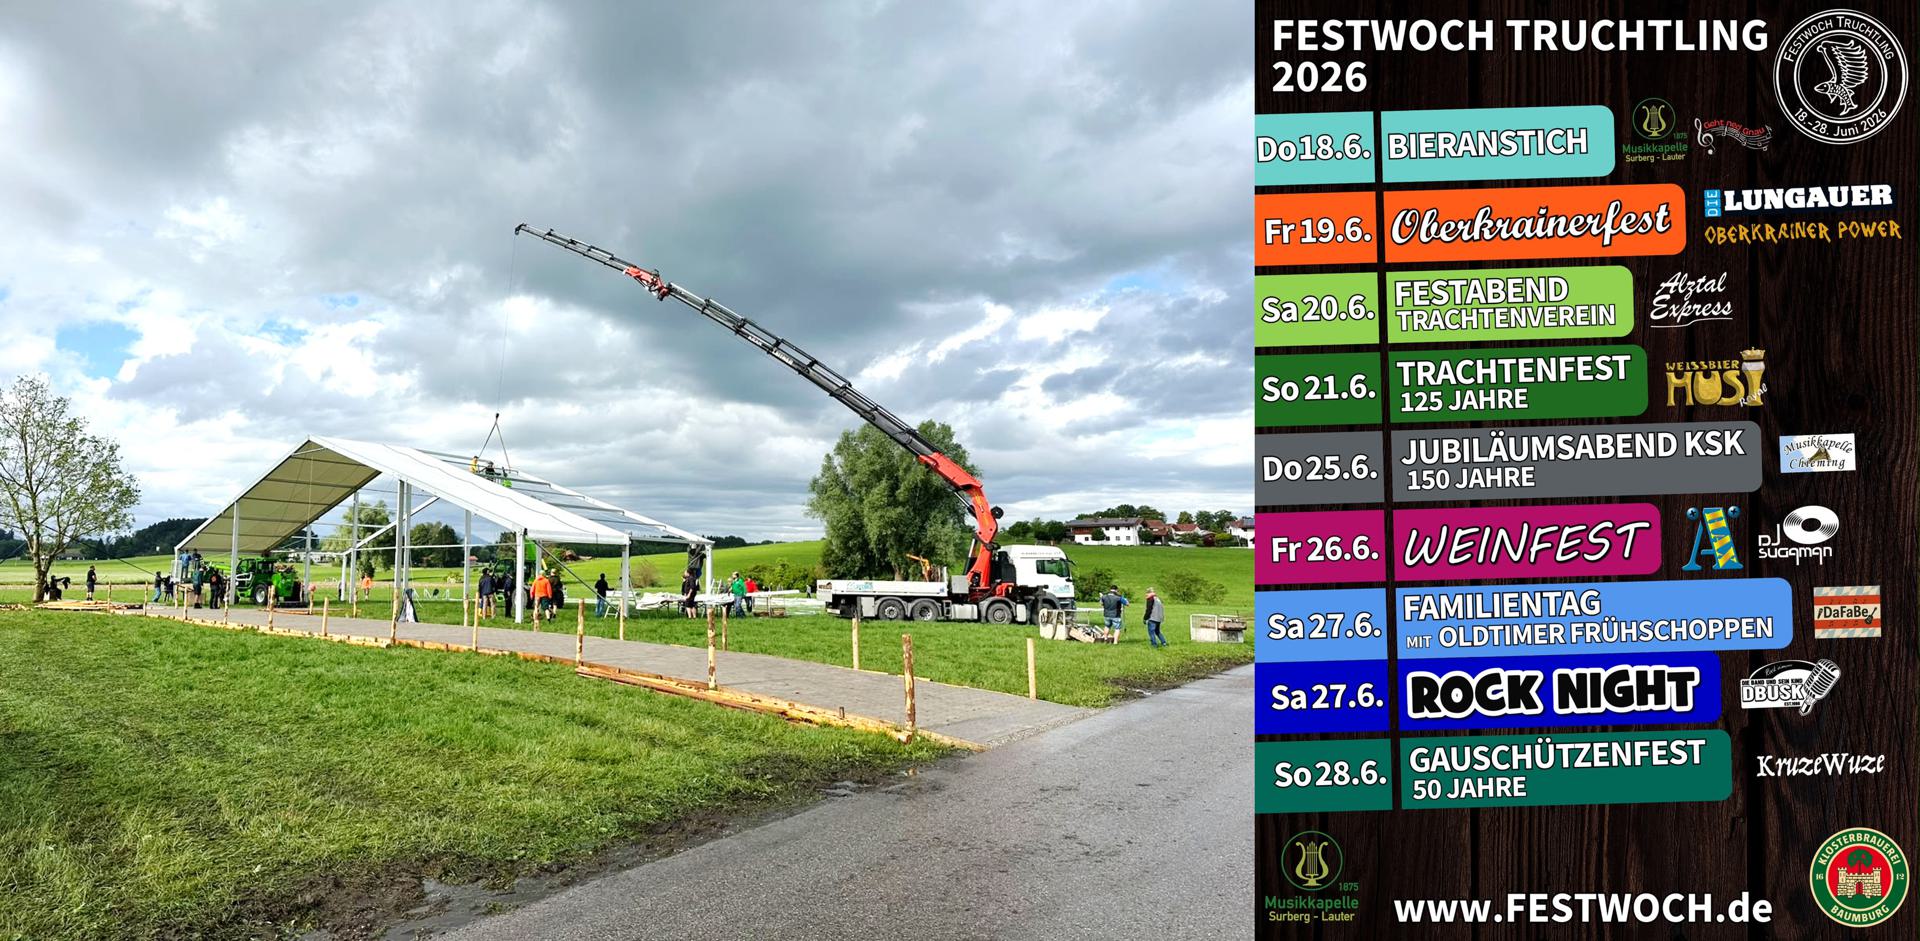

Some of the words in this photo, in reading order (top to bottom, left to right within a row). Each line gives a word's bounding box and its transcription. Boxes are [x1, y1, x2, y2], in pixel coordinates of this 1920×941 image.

[1273, 19, 1495, 51] FESTWOCH
[1506, 19, 1768, 51] TRUCHTLING
[1783, 19, 1833, 62] FESTWOCH
[1836, 16, 1895, 60] TRUCHTLING
[1272, 61, 1367, 92] 2026
[1833, 124, 1859, 137] Juni
[1861, 108, 1887, 132] 2026
[1257, 136, 1297, 162] Do
[1299, 133, 1371, 160] 18.6.
[1388, 128, 1588, 160] BIERANSTICH
[1622, 143, 1688, 154] Musikkapelle
[1625, 154, 1655, 163] Surberg
[1662, 153, 1685, 161] Lauter
[1706, 190, 1719, 216] DIE
[1724, 184, 1893, 211] LUNGAUER
[1265, 218, 1295, 245] Fr
[1300, 216, 1372, 243] 19.6.
[1391, 200, 1671, 246] Oberkrainerfest
[1704, 221, 1831, 245] OBERKRAINER
[1838, 219, 1902, 240] POWER
[1395, 276, 1569, 307] FESTABEND
[1656, 271, 1728, 300] Alztal
[1262, 296, 1298, 323] Sa
[1302, 294, 1375, 321] 20.6.
[1396, 303, 1616, 331] TRACHTENVEREIN
[1650, 294, 1733, 323] Express
[1396, 355, 1631, 387] TRACHTENFEST
[1666, 360, 1740, 371] WEISSBIER
[1262, 376, 1300, 402] So
[1304, 374, 1376, 400] 21.6.
[1400, 391, 1443, 412] 125
[1448, 388, 1528, 411] JAHRE
[1400, 430, 1677, 465] JUBILÄUMSABEND
[1684, 429, 1745, 457] KSK
[1783, 435, 1853, 455] Musikkapelle
[1262, 456, 1301, 482] Do
[1306, 454, 1378, 481] 25.6.
[1407, 469, 1450, 491] 150
[1455, 466, 1536, 489] JAHRE
[1271, 536, 1301, 562] Fr
[1307, 534, 1379, 561] 26.6.
[1404, 521, 1650, 566] WEINFEST
[1758, 524, 1781, 547] DJ
[1403, 589, 1601, 621] FAMILIENTAG
[1823, 605, 1868, 619] DaFaBe
[1267, 613, 1304, 640] Sa
[1309, 611, 1382, 638] 27.6.
[1406, 635, 1432, 648] MIT
[1439, 623, 1565, 648] OLDTIMER
[1571, 616, 1773, 645] FRÜHSCHOPPEN
[1271, 684, 1307, 710] Sa
[1311, 682, 1384, 709] 27.6.
[1406, 667, 1544, 719] ROCK
[1552, 663, 1701, 716] NIGHT
[1742, 684, 1804, 703] DBUSK
[1409, 737, 1706, 774] GAUSCHÜTZENFEST
[1756, 752, 1886, 777] KruzeWuze
[1274, 762, 1312, 788] So
[1315, 760, 1387, 787] 28.6.
[1412, 779, 1442, 801] 50
[1447, 776, 1528, 799] JAHRE
[1818, 833, 1902, 866] KLOSTERBRAUEREI
[1338, 882, 1360, 892] 1875
[1264, 895, 1360, 912] Musikkapelle
[1268, 910, 1311, 924] Surberg
[1321, 911, 1356, 922] Lauter
[1394, 892, 1773, 923] www.FESTWOCH.de
[1830, 904, 1890, 923] BAUMBURG
